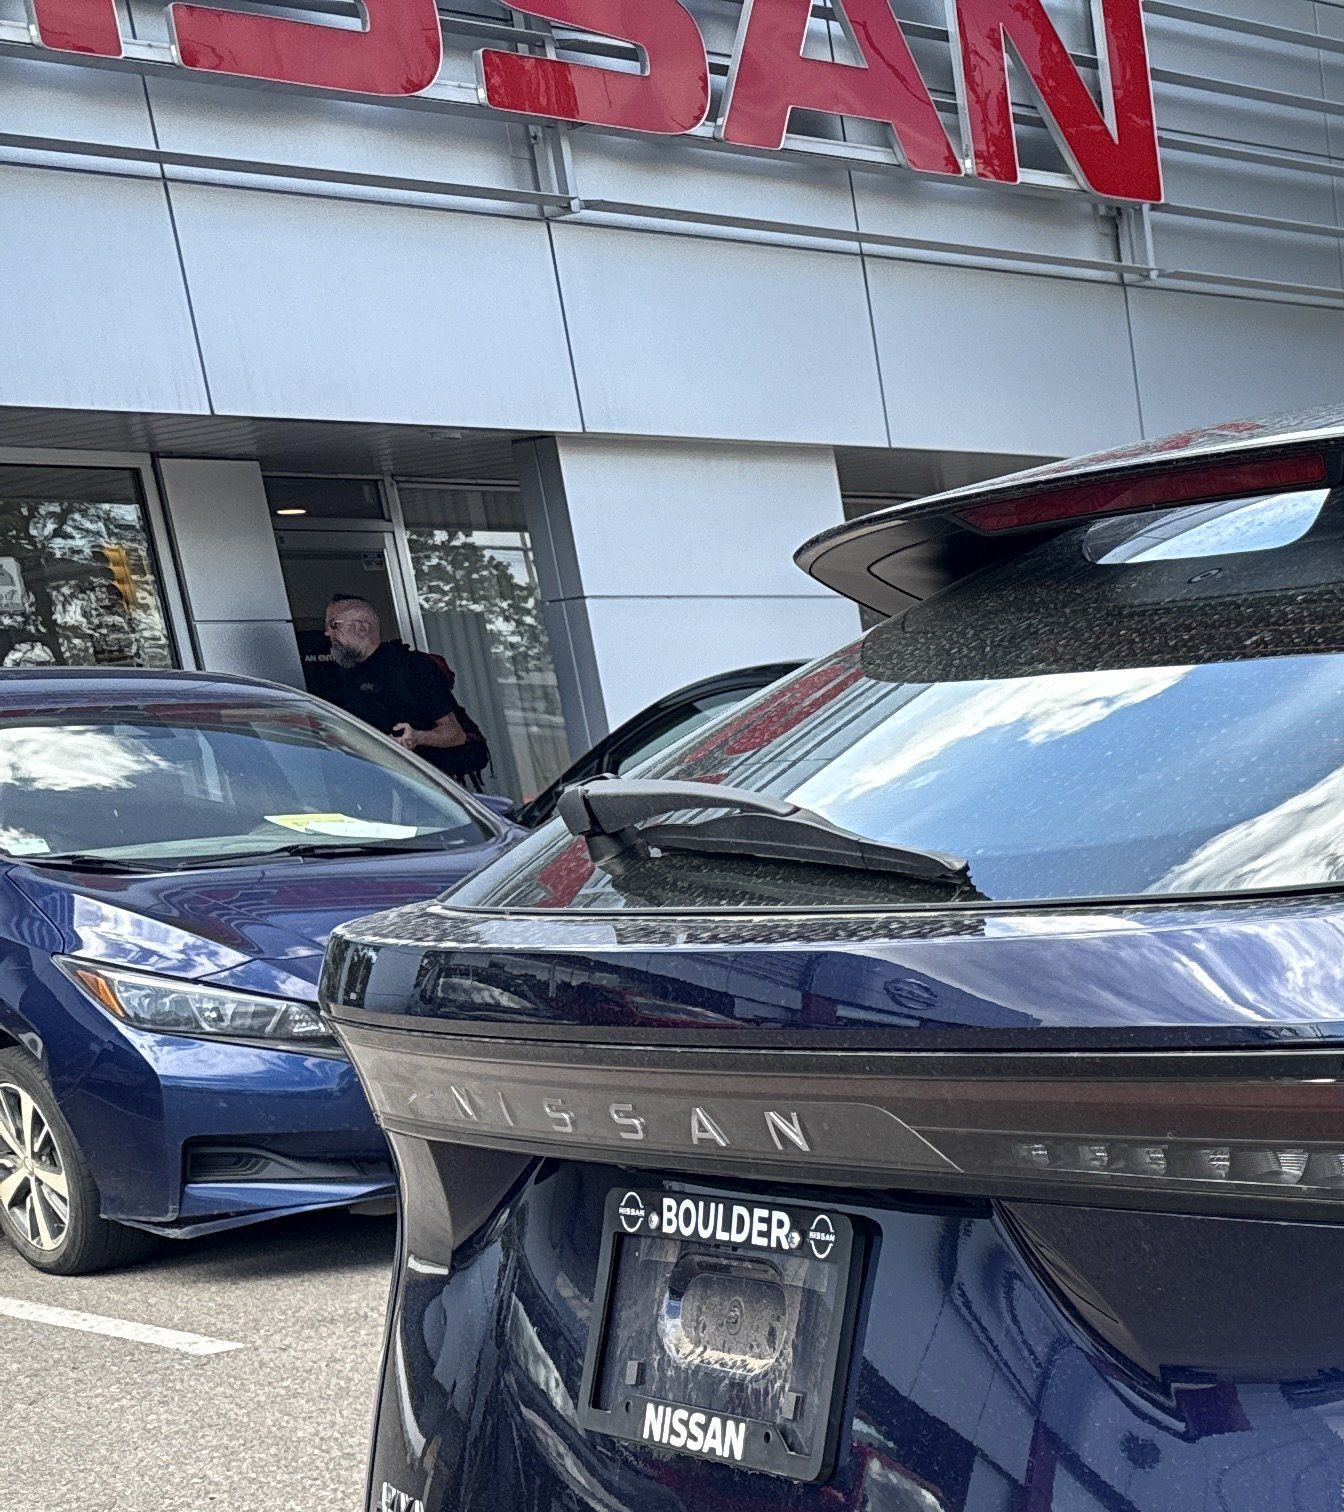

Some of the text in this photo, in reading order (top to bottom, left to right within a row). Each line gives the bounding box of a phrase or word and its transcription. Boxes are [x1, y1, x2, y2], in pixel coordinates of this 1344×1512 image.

[450, 1085, 811, 1152] NISSAN
[619, 1206, 645, 1217] NISSAN
[661, 1198, 791, 1250] BOULDER
[809, 1231, 836, 1242] NISSAN
[643, 1402, 746, 1461] NISSAN
